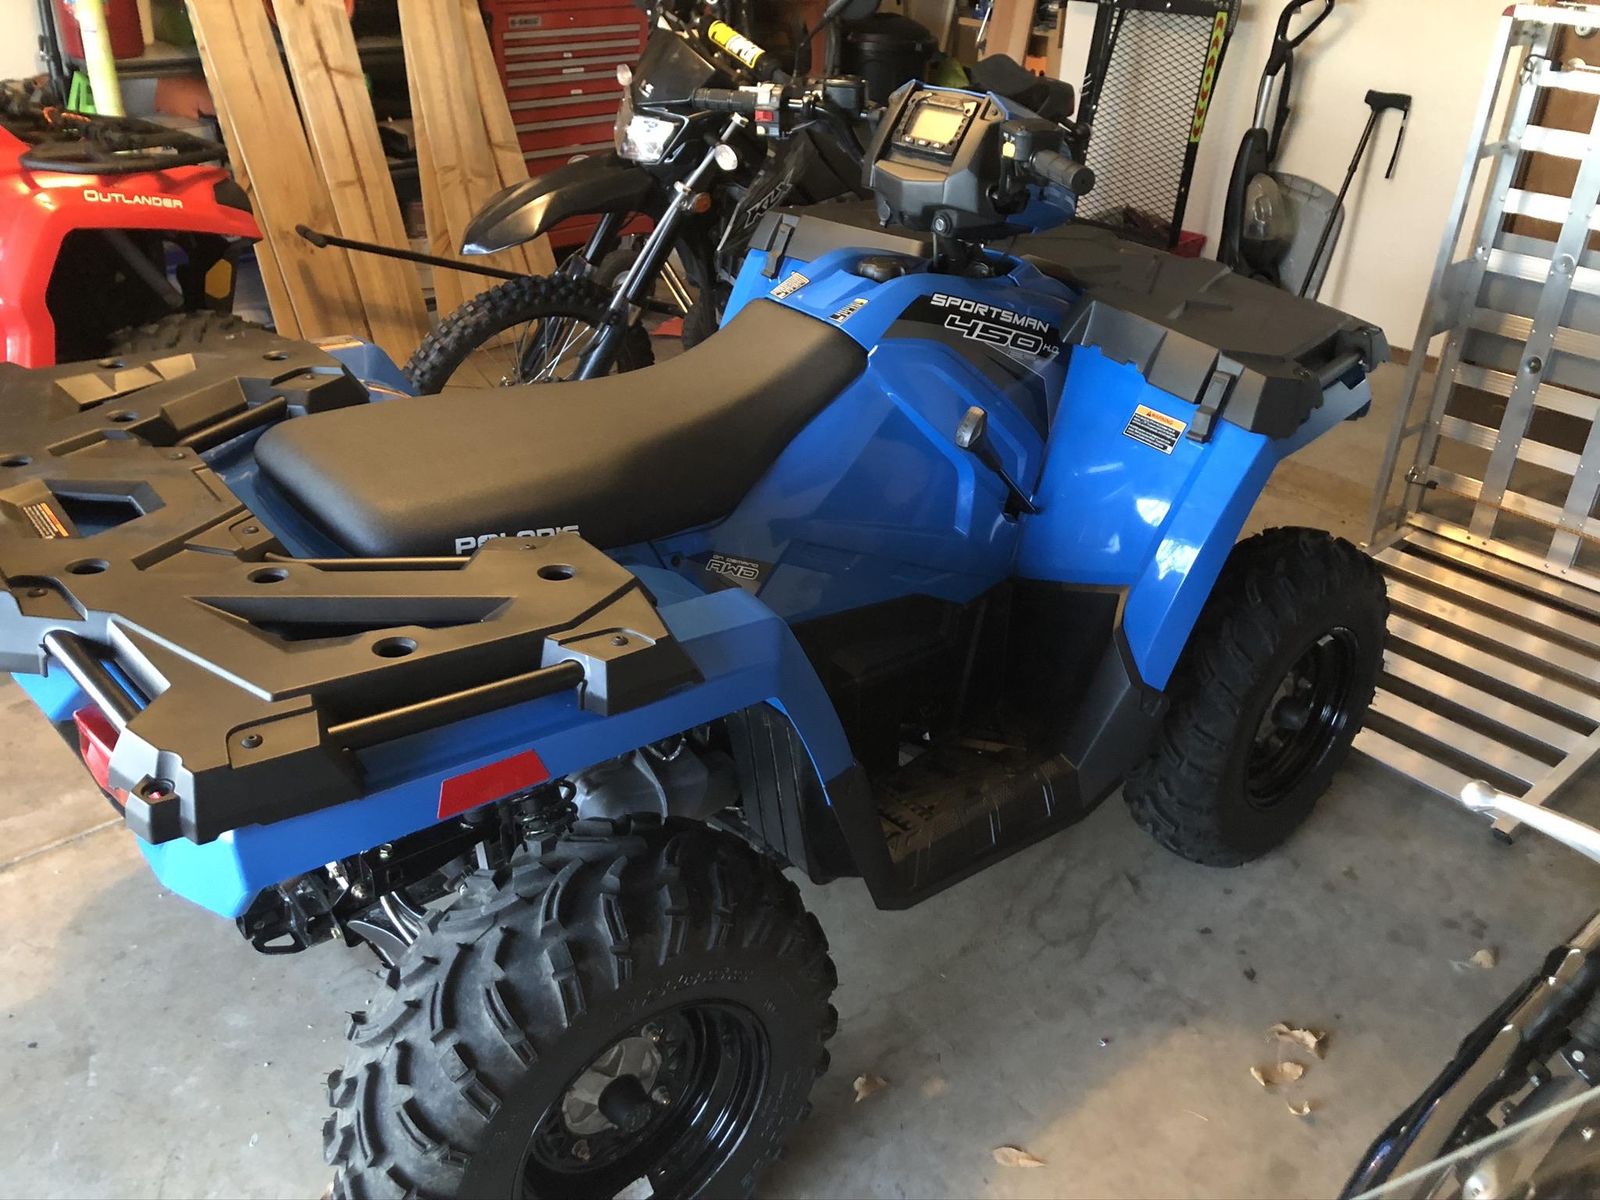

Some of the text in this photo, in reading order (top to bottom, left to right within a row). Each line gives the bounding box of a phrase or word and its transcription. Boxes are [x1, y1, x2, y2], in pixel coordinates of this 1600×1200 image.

[83, 189, 184, 208] OUTLANDER
[930, 293, 1049, 333] SPORTSMAN
[944, 314, 1044, 355] 450
[455, 525, 580, 555] PORS
[705, 559, 760, 581] AWD
